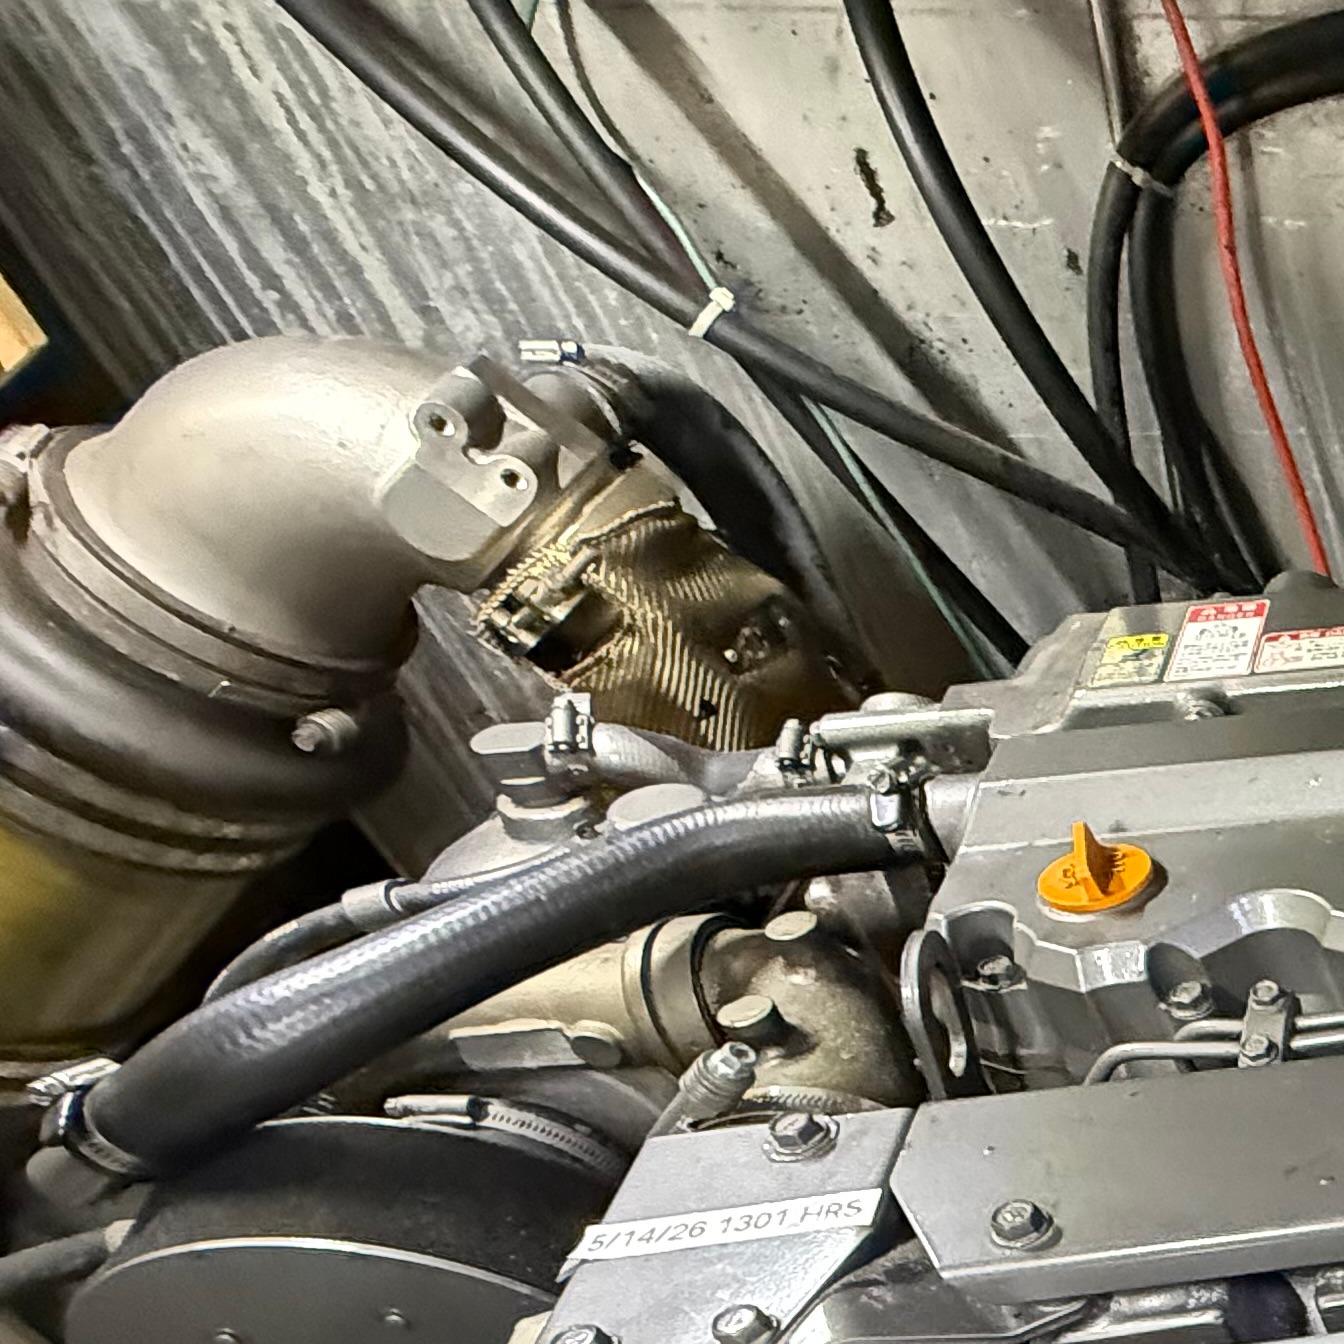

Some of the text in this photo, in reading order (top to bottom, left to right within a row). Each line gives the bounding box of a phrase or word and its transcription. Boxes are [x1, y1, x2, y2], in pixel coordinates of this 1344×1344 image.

[587, 1198, 863, 1252] 5/14/26 1301 HRS
